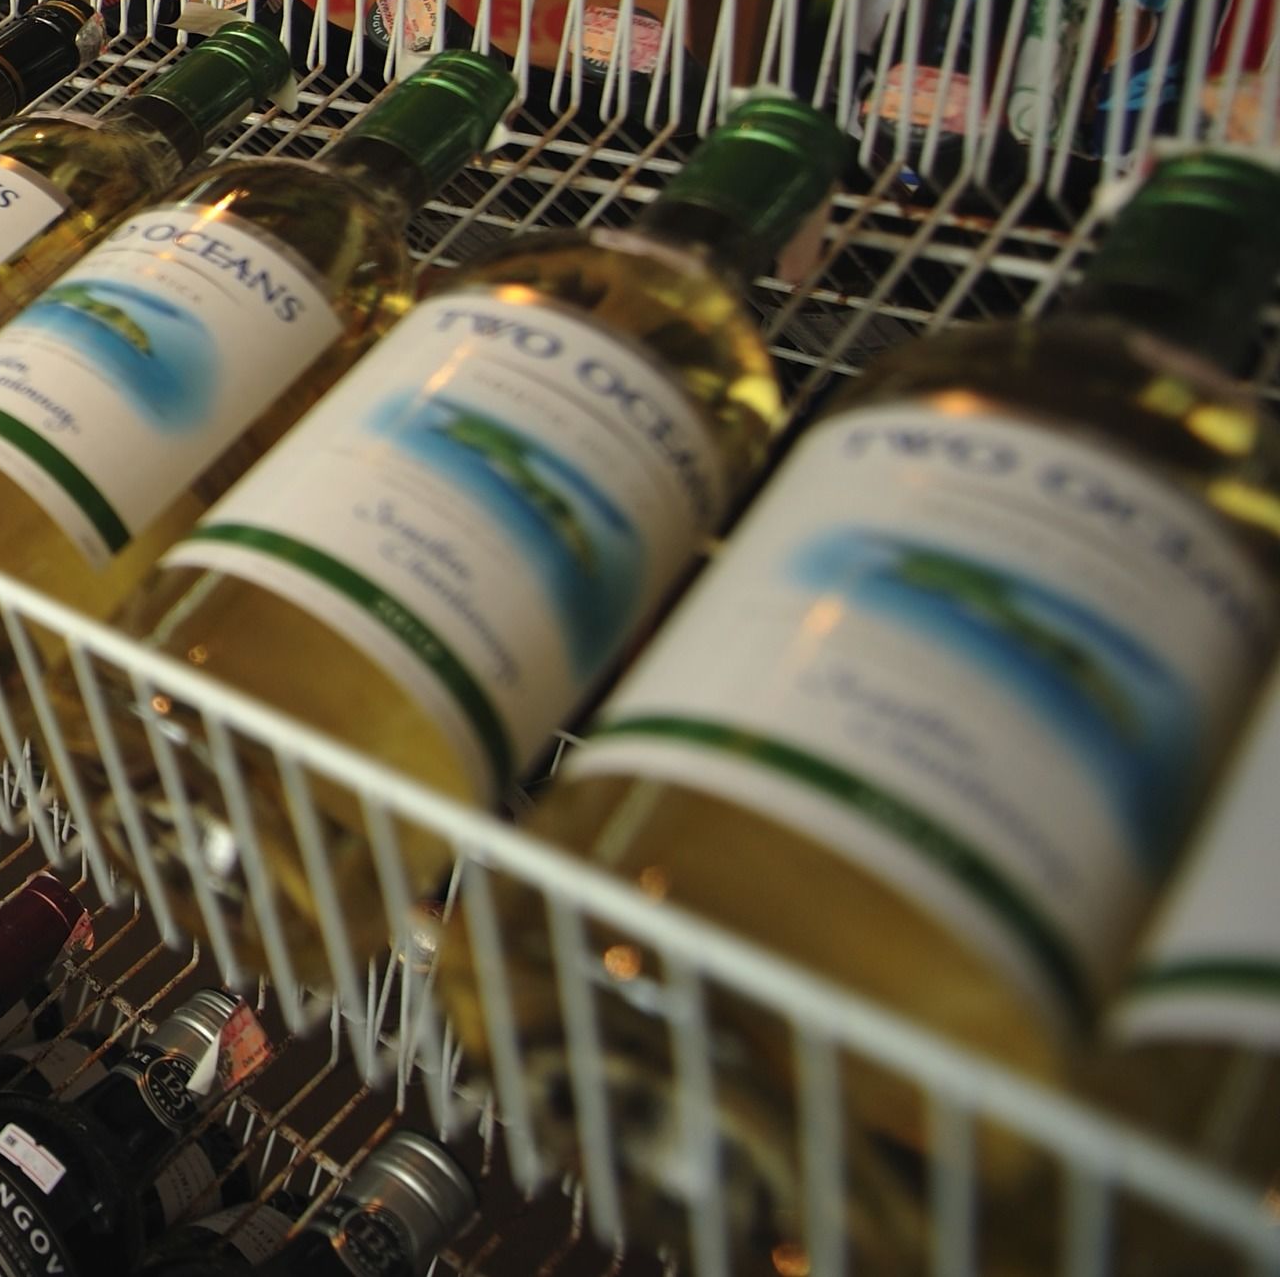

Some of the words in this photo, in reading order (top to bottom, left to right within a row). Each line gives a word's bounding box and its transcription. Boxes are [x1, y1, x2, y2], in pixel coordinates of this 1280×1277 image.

[142, 223, 308, 325] OCEANS
[436, 308, 564, 361] TWO
[160, 1070, 192, 1110] 125
